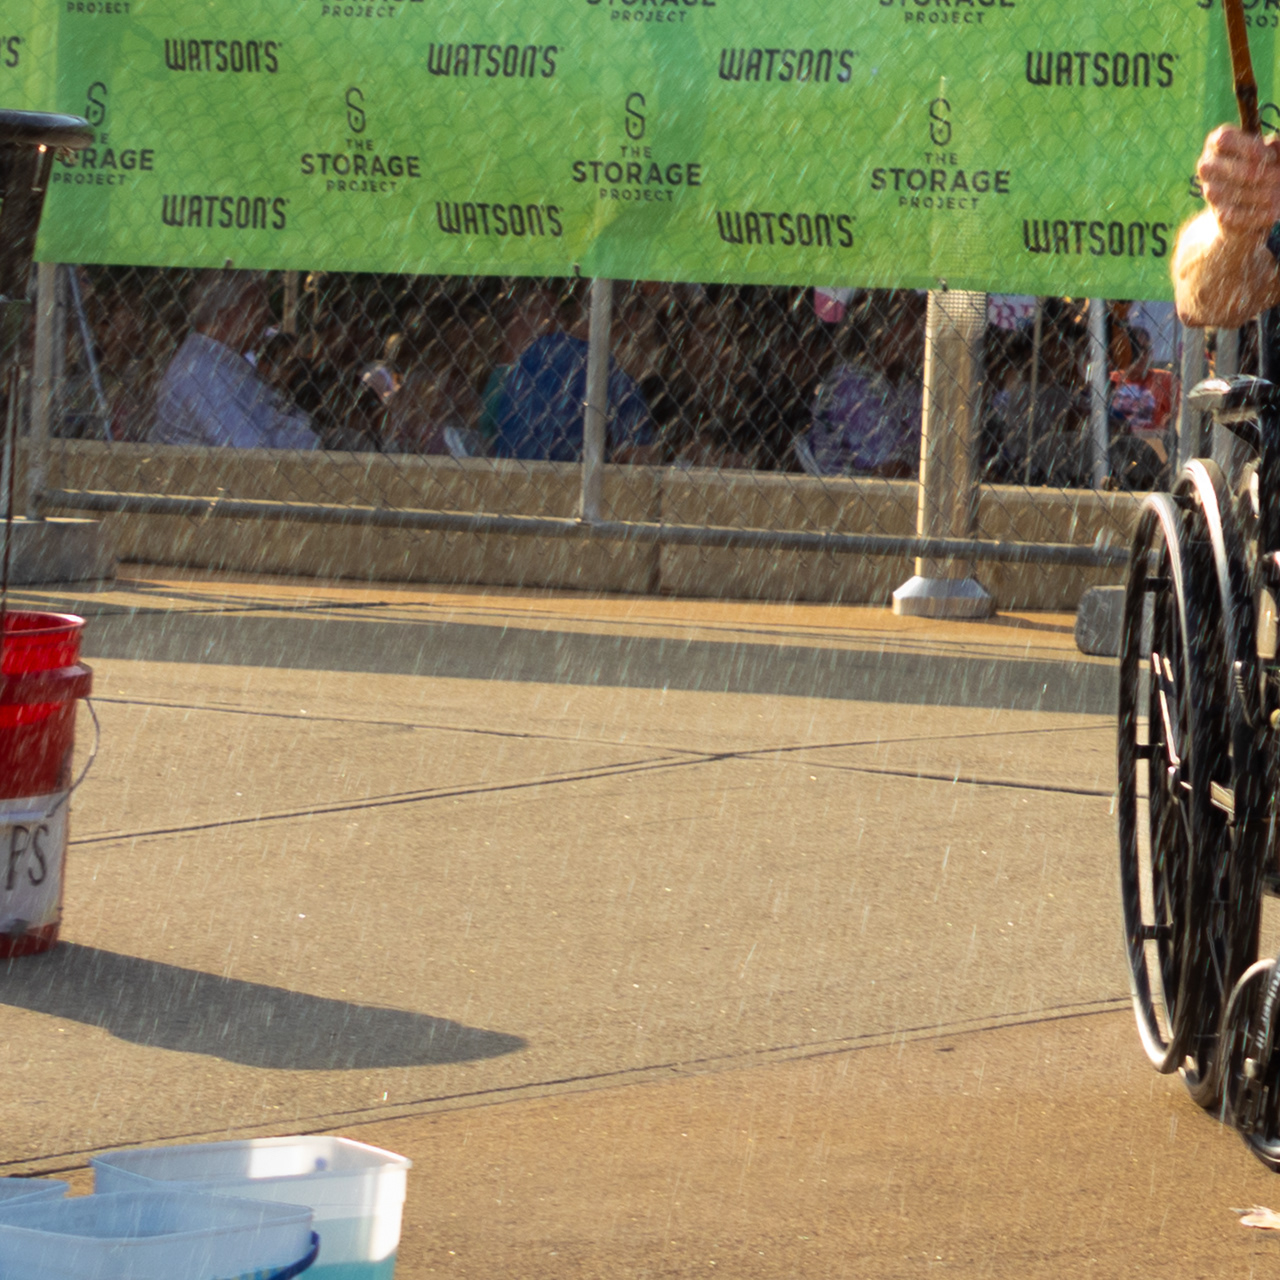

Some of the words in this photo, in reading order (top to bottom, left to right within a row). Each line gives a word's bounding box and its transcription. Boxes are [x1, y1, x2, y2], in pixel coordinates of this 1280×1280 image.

[67, 2, 131, 14] PROJECT
[322, 6, 395, 18] PROJECT
[611, 10, 687, 22] PROJECT
[905, 11, 985, 24] PROJECT
[165, 40, 278, 73] WATSON'S
[428, 43, 557, 78] WATSON'S
[719, 49, 854, 83] WATSON'S
[1027, 51, 1174, 88] WATSON'S
[347, 140, 374, 151] THE
[621, 146, 651, 158] THE
[301, 155, 421, 178] STORAGE
[925, 153, 957, 165] THE
[53, 172, 126, 185] PROJECT
[573, 162, 702, 187] STORAGE
[871, 169, 1010, 194] STORAGE
[326, 180, 396, 192] PROJECT
[599, 188, 673, 201] PROJECT
[899, 196, 979, 210] PROJECT
[163, 195, 287, 230] WATSON'S
[436, 201, 562, 237] WATSON'S
[717, 212, 854, 248] WATSON'S
[1023, 219, 1168, 257] WATSON'S
